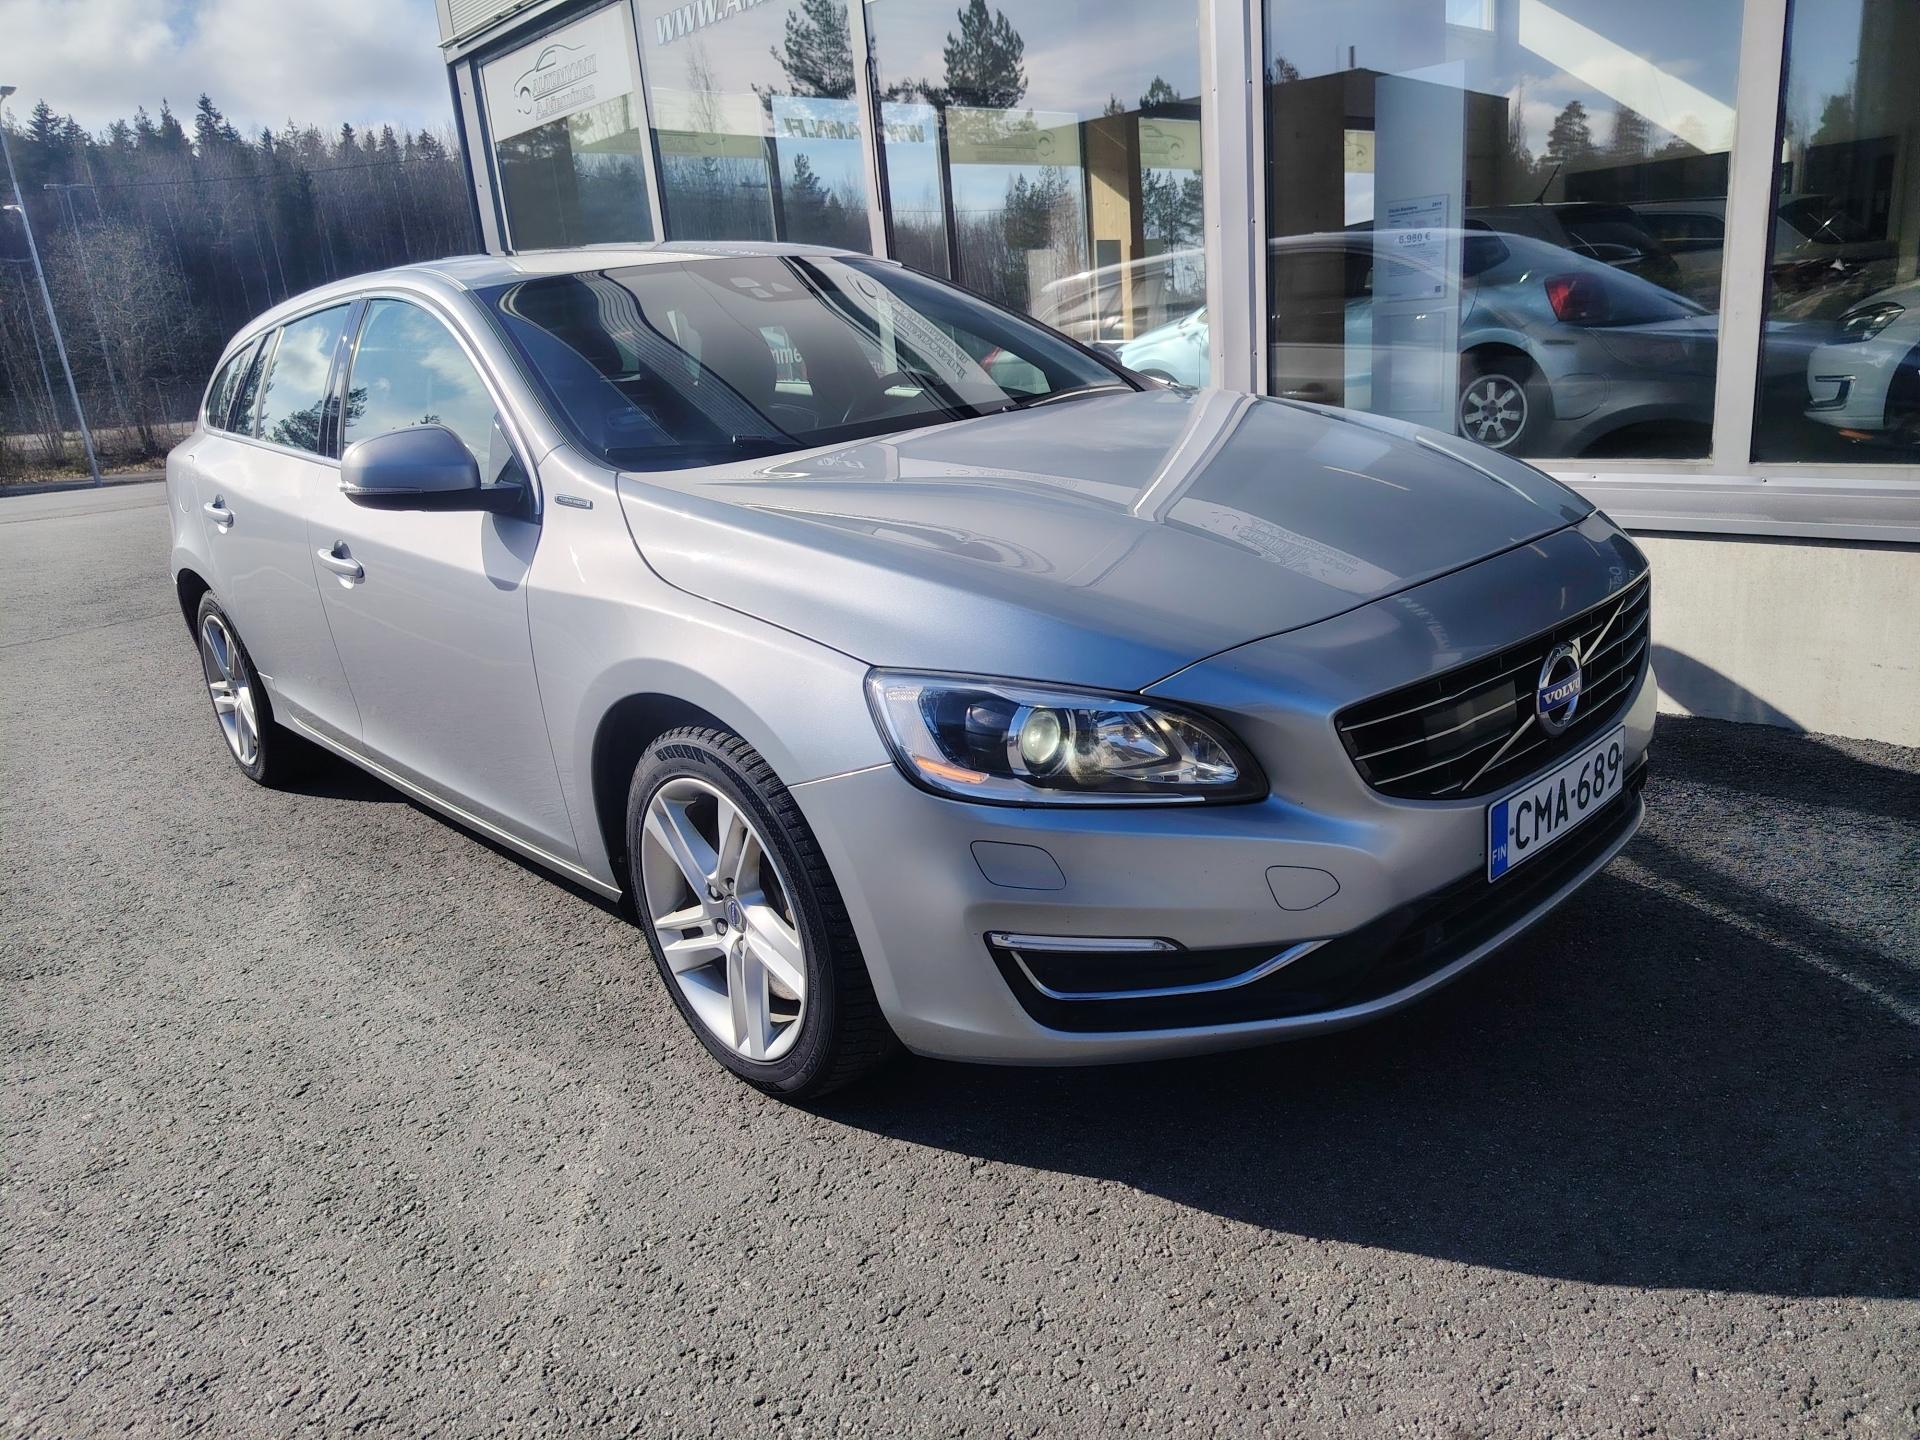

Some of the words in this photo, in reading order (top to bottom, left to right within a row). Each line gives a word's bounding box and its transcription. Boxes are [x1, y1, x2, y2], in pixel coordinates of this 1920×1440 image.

[1543, 678, 1580, 704] VOLVO
[1515, 742, 1620, 850] CMA-689
[1492, 843, 1507, 865] FIN
